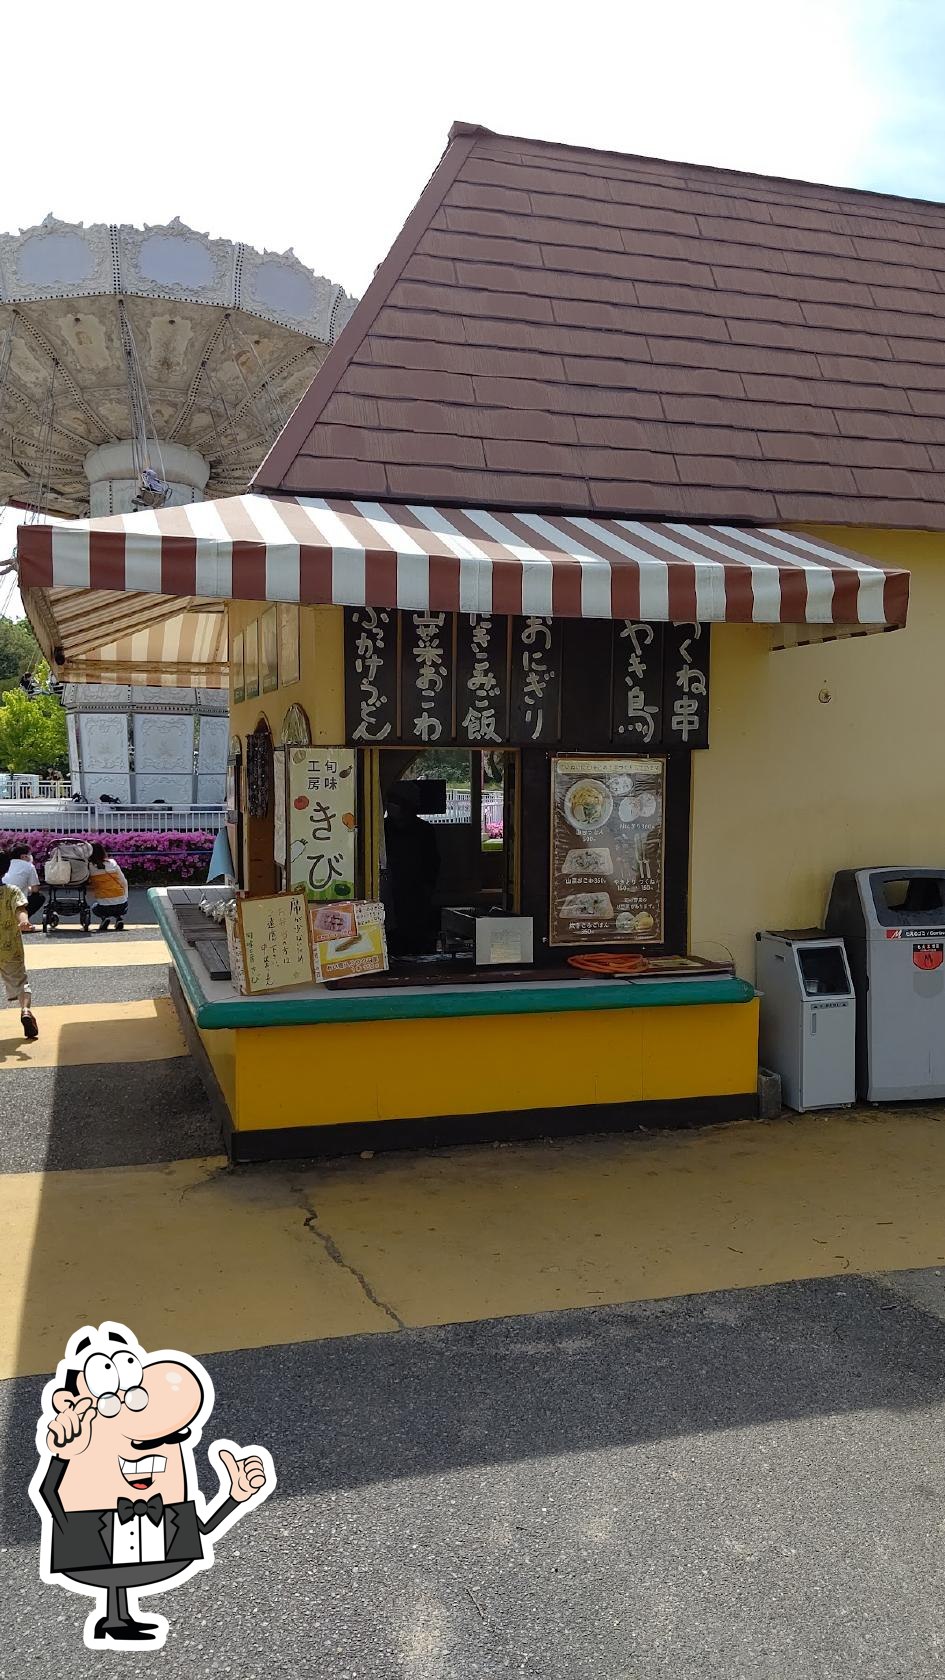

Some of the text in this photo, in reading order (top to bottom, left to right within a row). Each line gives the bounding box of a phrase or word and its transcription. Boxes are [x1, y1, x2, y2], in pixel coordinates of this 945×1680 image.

[413, 609, 447, 742] 山菜おこわ
[521, 615, 555, 740] おにぎり
[618, 619, 659, 743] やき鳥
[306, 801, 344, 890] きび
